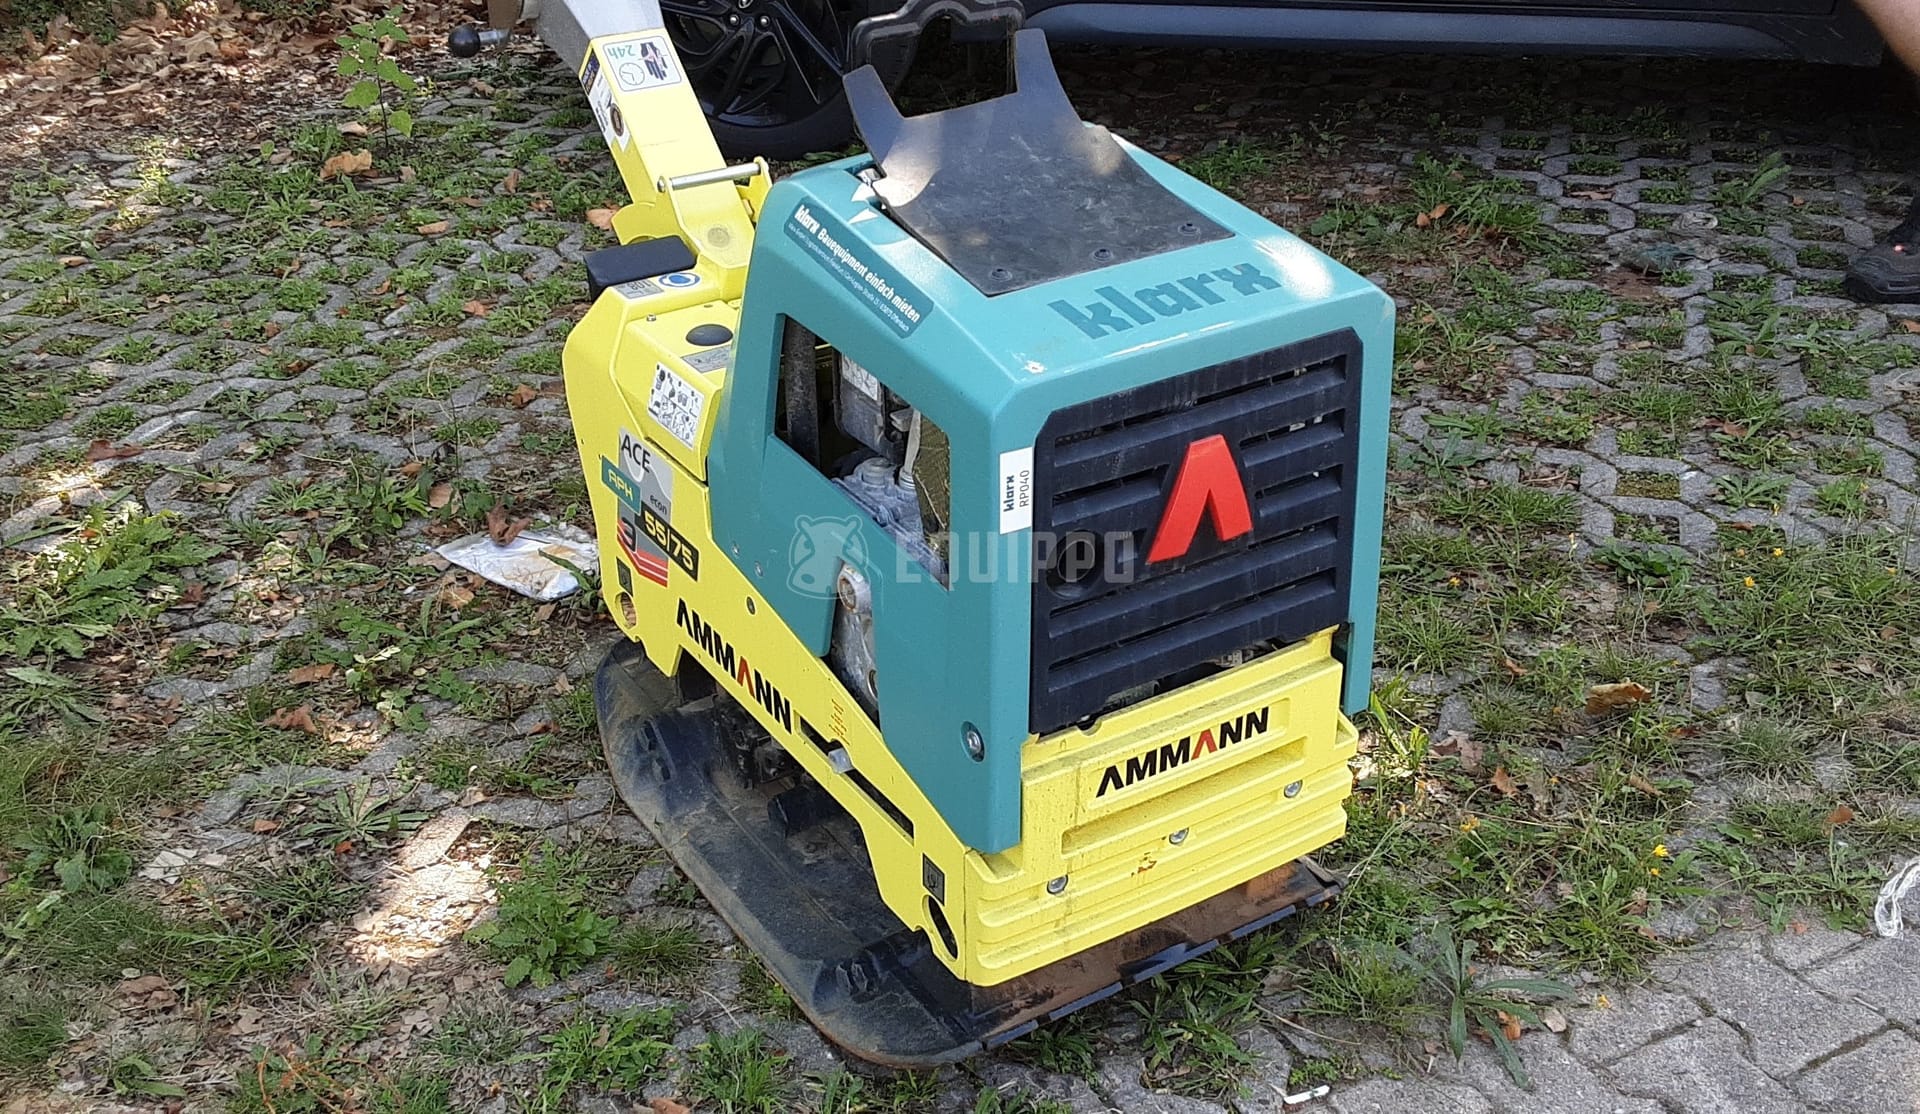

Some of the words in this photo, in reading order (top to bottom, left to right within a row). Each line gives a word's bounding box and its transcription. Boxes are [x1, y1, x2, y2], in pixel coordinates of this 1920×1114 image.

[607, 44, 636, 59] 24h
[794, 203, 820, 234] klarx
[818, 228, 869, 277] Bauequipment
[864, 271, 895, 300] einfach
[891, 294, 921, 323] mieten
[1047, 262, 1283, 340] klarx
[621, 434, 651, 474] ACE
[649, 494, 668, 516] econ
[1003, 474, 1015, 513] klarx
[1018, 469, 1030, 508] RP040
[676, 597, 793, 735] AMMANN
[1095, 706, 1270, 798] AMMANN
